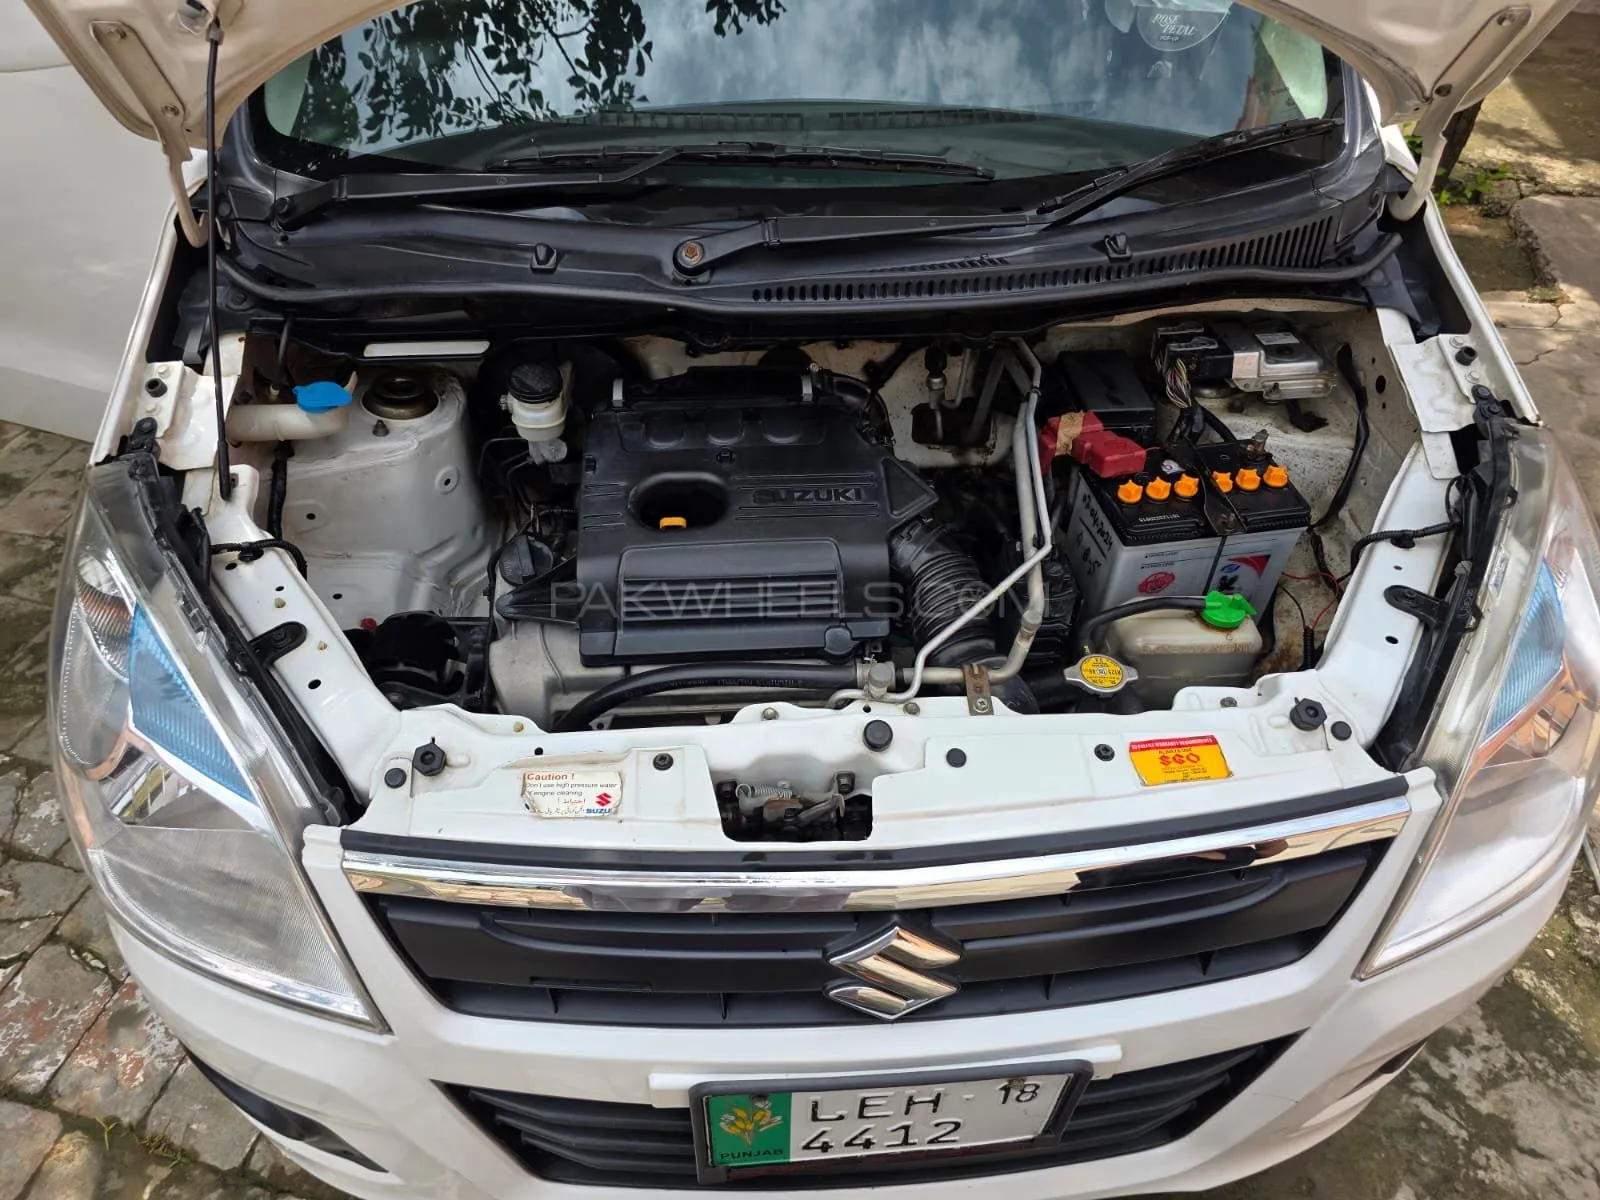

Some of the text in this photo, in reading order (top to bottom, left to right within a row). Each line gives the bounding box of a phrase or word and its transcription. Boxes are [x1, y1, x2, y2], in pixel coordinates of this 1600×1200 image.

[1152, 13, 1181, 26] ROSE
[1162, 25, 1195, 36] PETAL
[754, 487, 862, 505] SUZUKI
[526, 773, 568, 781] Caution
[810, 1080, 1041, 1122] LEH 18
[801, 1120, 962, 1153] 4412
[719, 1148, 784, 1160] PUNJAB
